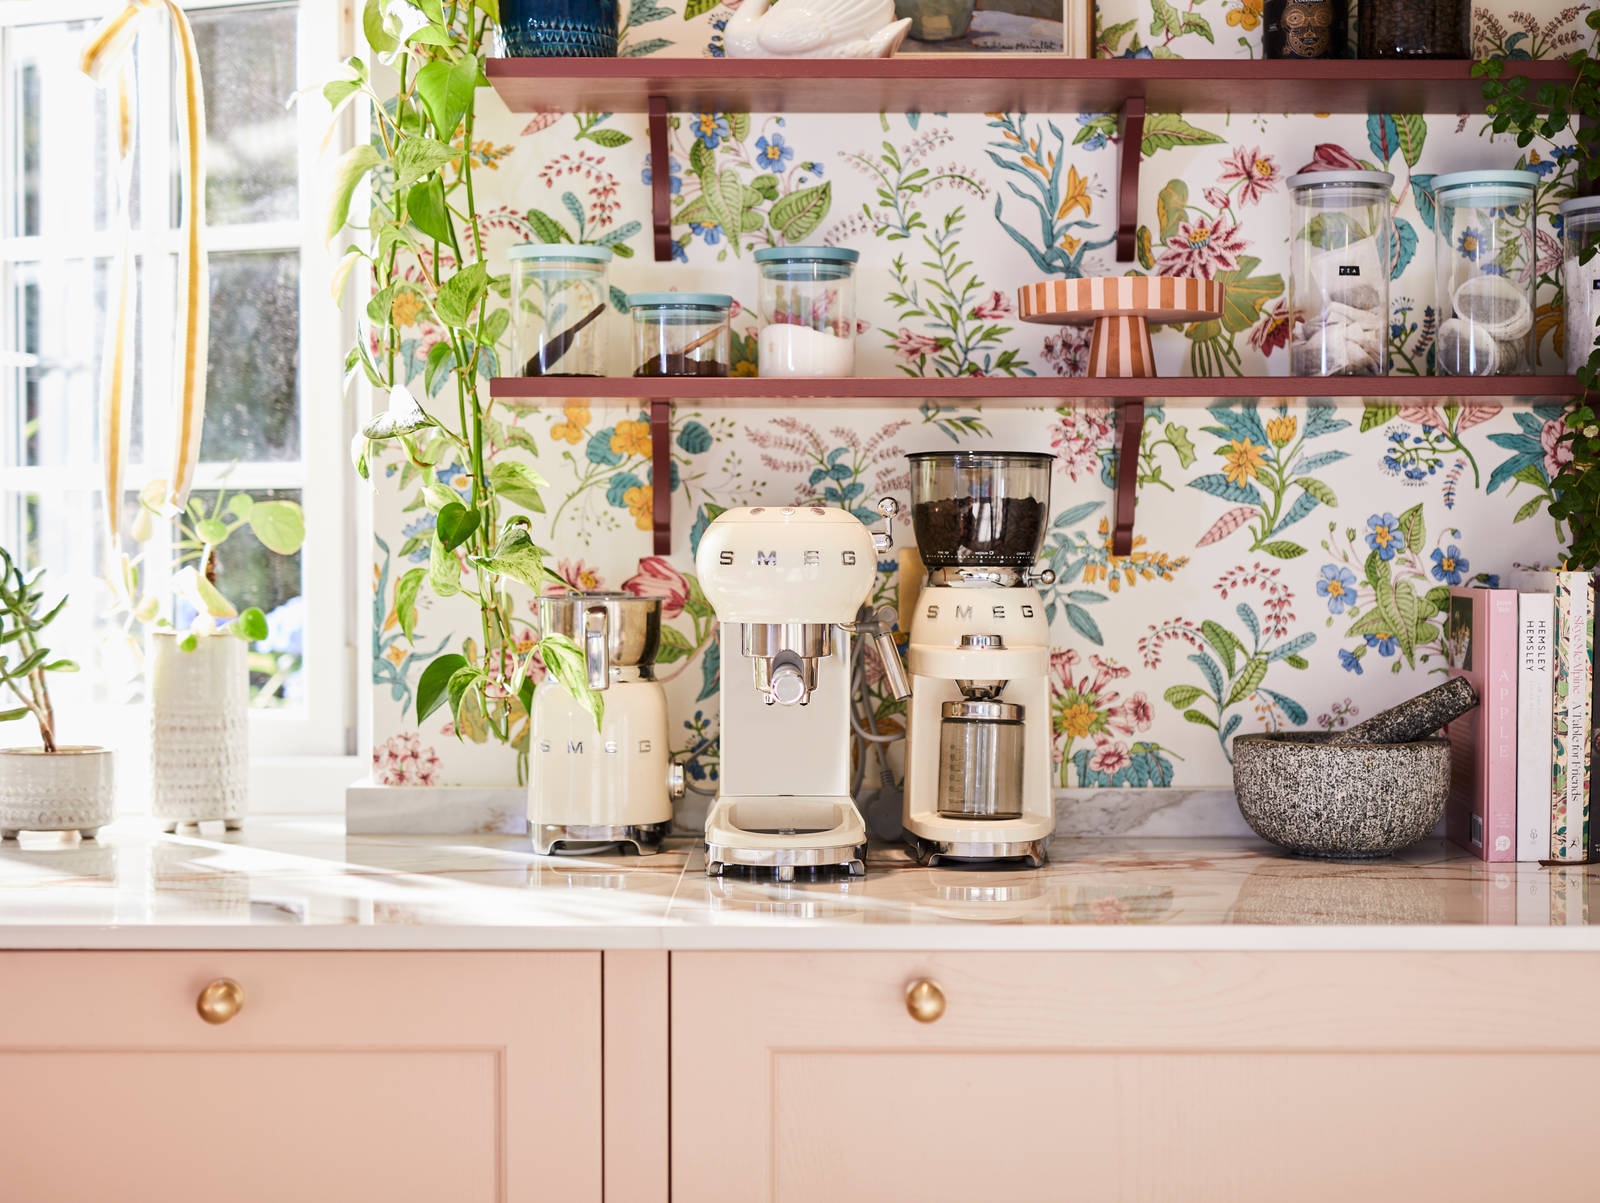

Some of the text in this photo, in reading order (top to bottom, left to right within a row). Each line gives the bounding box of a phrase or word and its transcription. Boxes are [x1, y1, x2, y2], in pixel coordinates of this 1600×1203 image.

[719, 550, 856, 566] SMEG
[926, 604, 1034, 619] SMEG
[1572, 615, 1585, 640] Skye
[1526, 620, 1535, 671] HEMSLEY
[1537, 620, 1546, 671] HEMSLEY
[1498, 671, 1510, 759] APPLE
[1571, 713, 1583, 743] Table
[539, 739, 652, 755] SMEG
[1571, 744, 1583, 759] for
[1570, 761, 1582, 802] Friends
